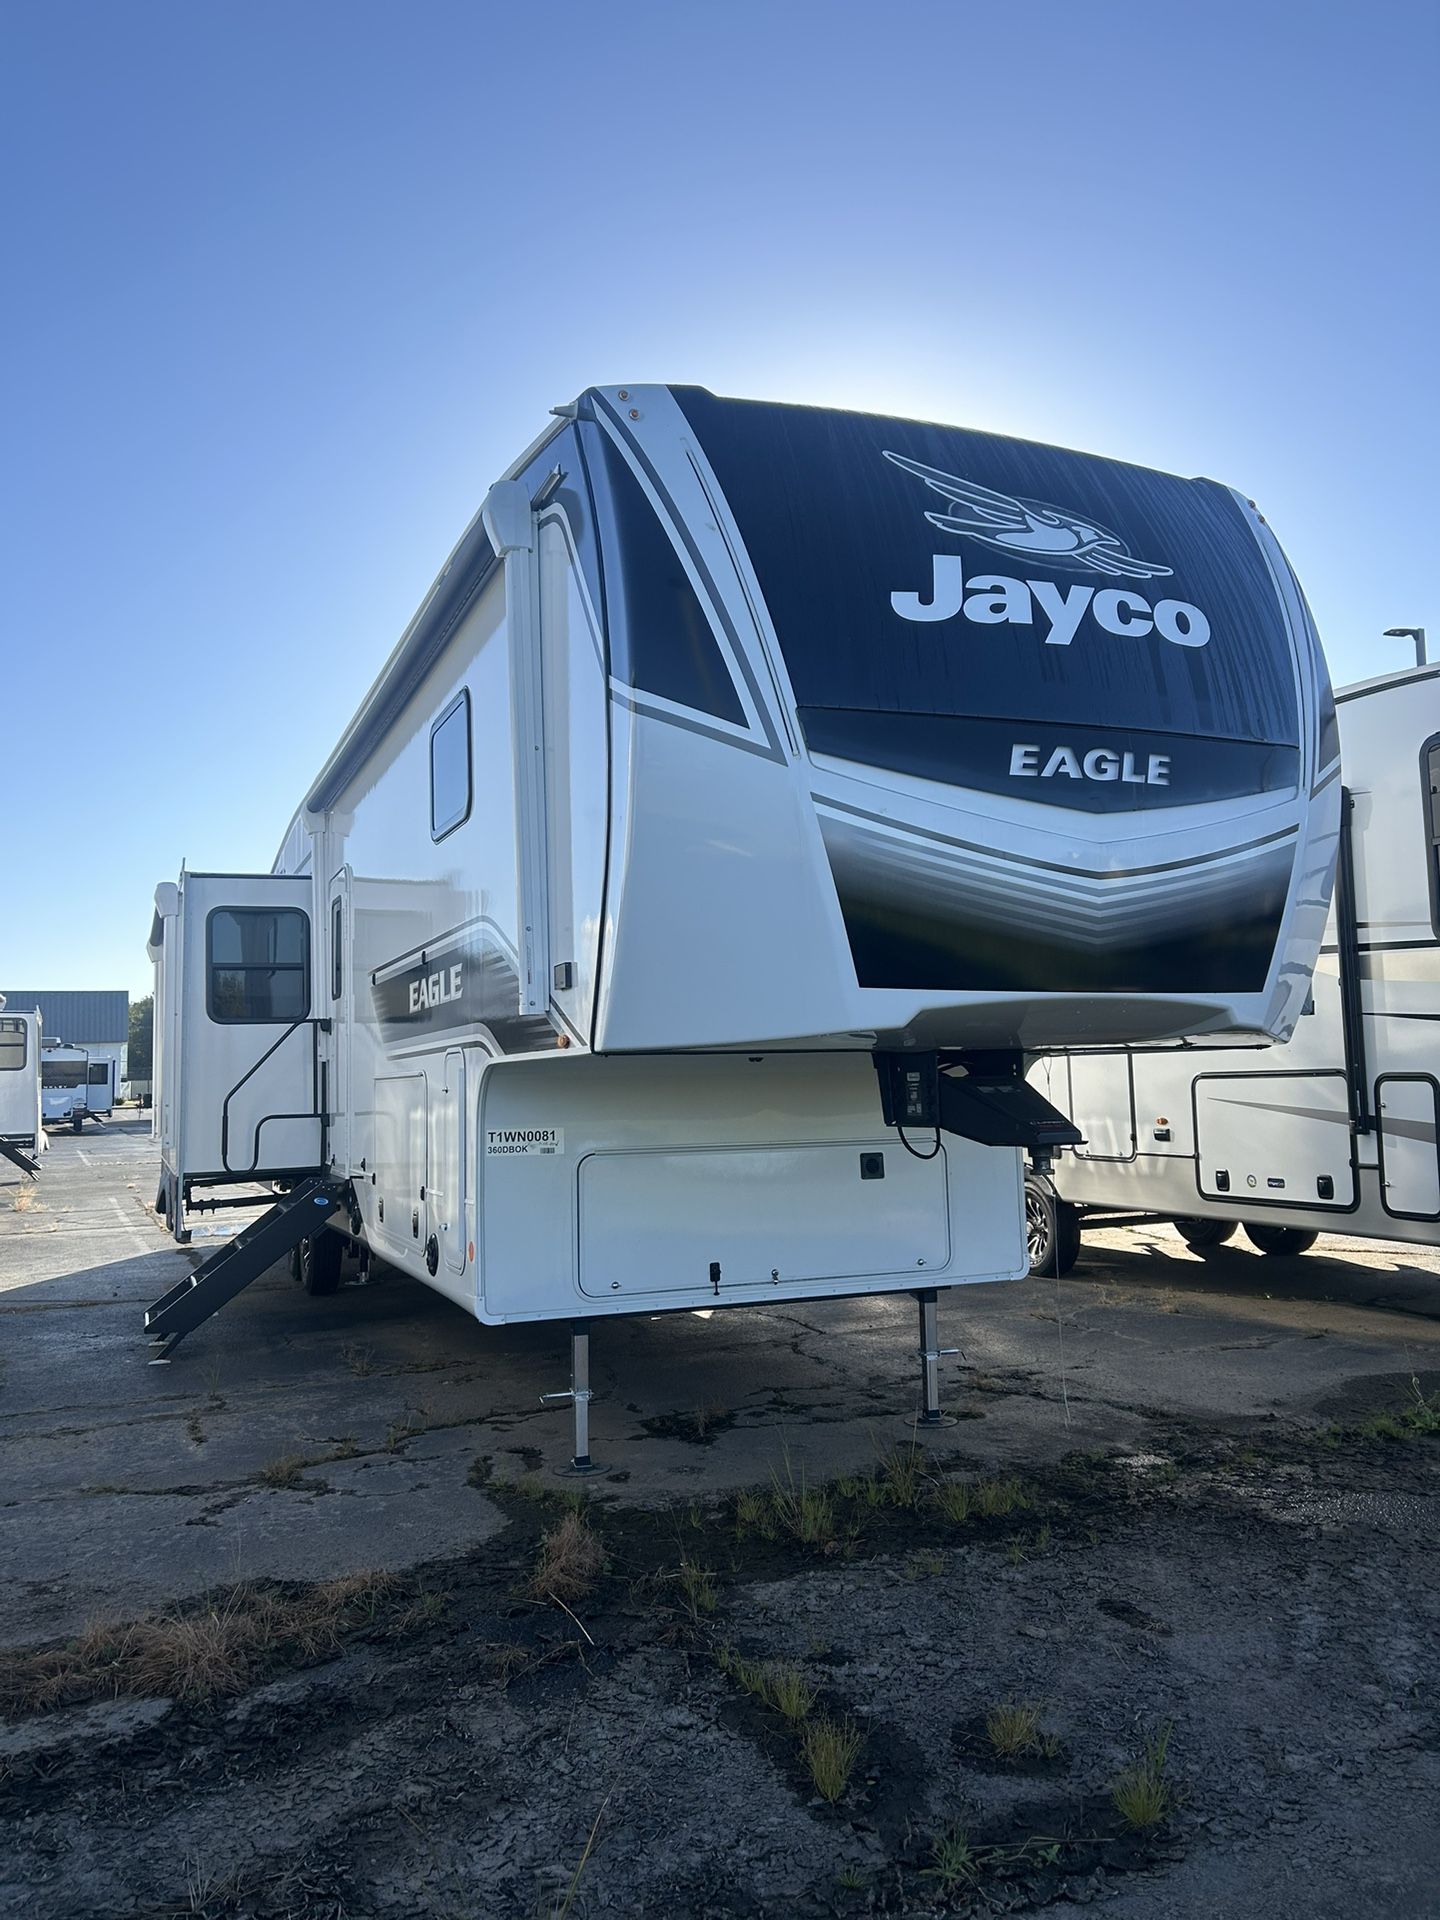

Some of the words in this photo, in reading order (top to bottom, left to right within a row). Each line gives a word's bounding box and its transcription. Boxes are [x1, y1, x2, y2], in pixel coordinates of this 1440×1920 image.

[889, 554, 1211, 648] Jayco
[1009, 743, 1171, 786] EAGLE
[409, 963, 463, 1014] EAGLE
[487, 1130, 556, 1143] T1WN0081
[487, 1145, 528, 1154] 360DBOK
